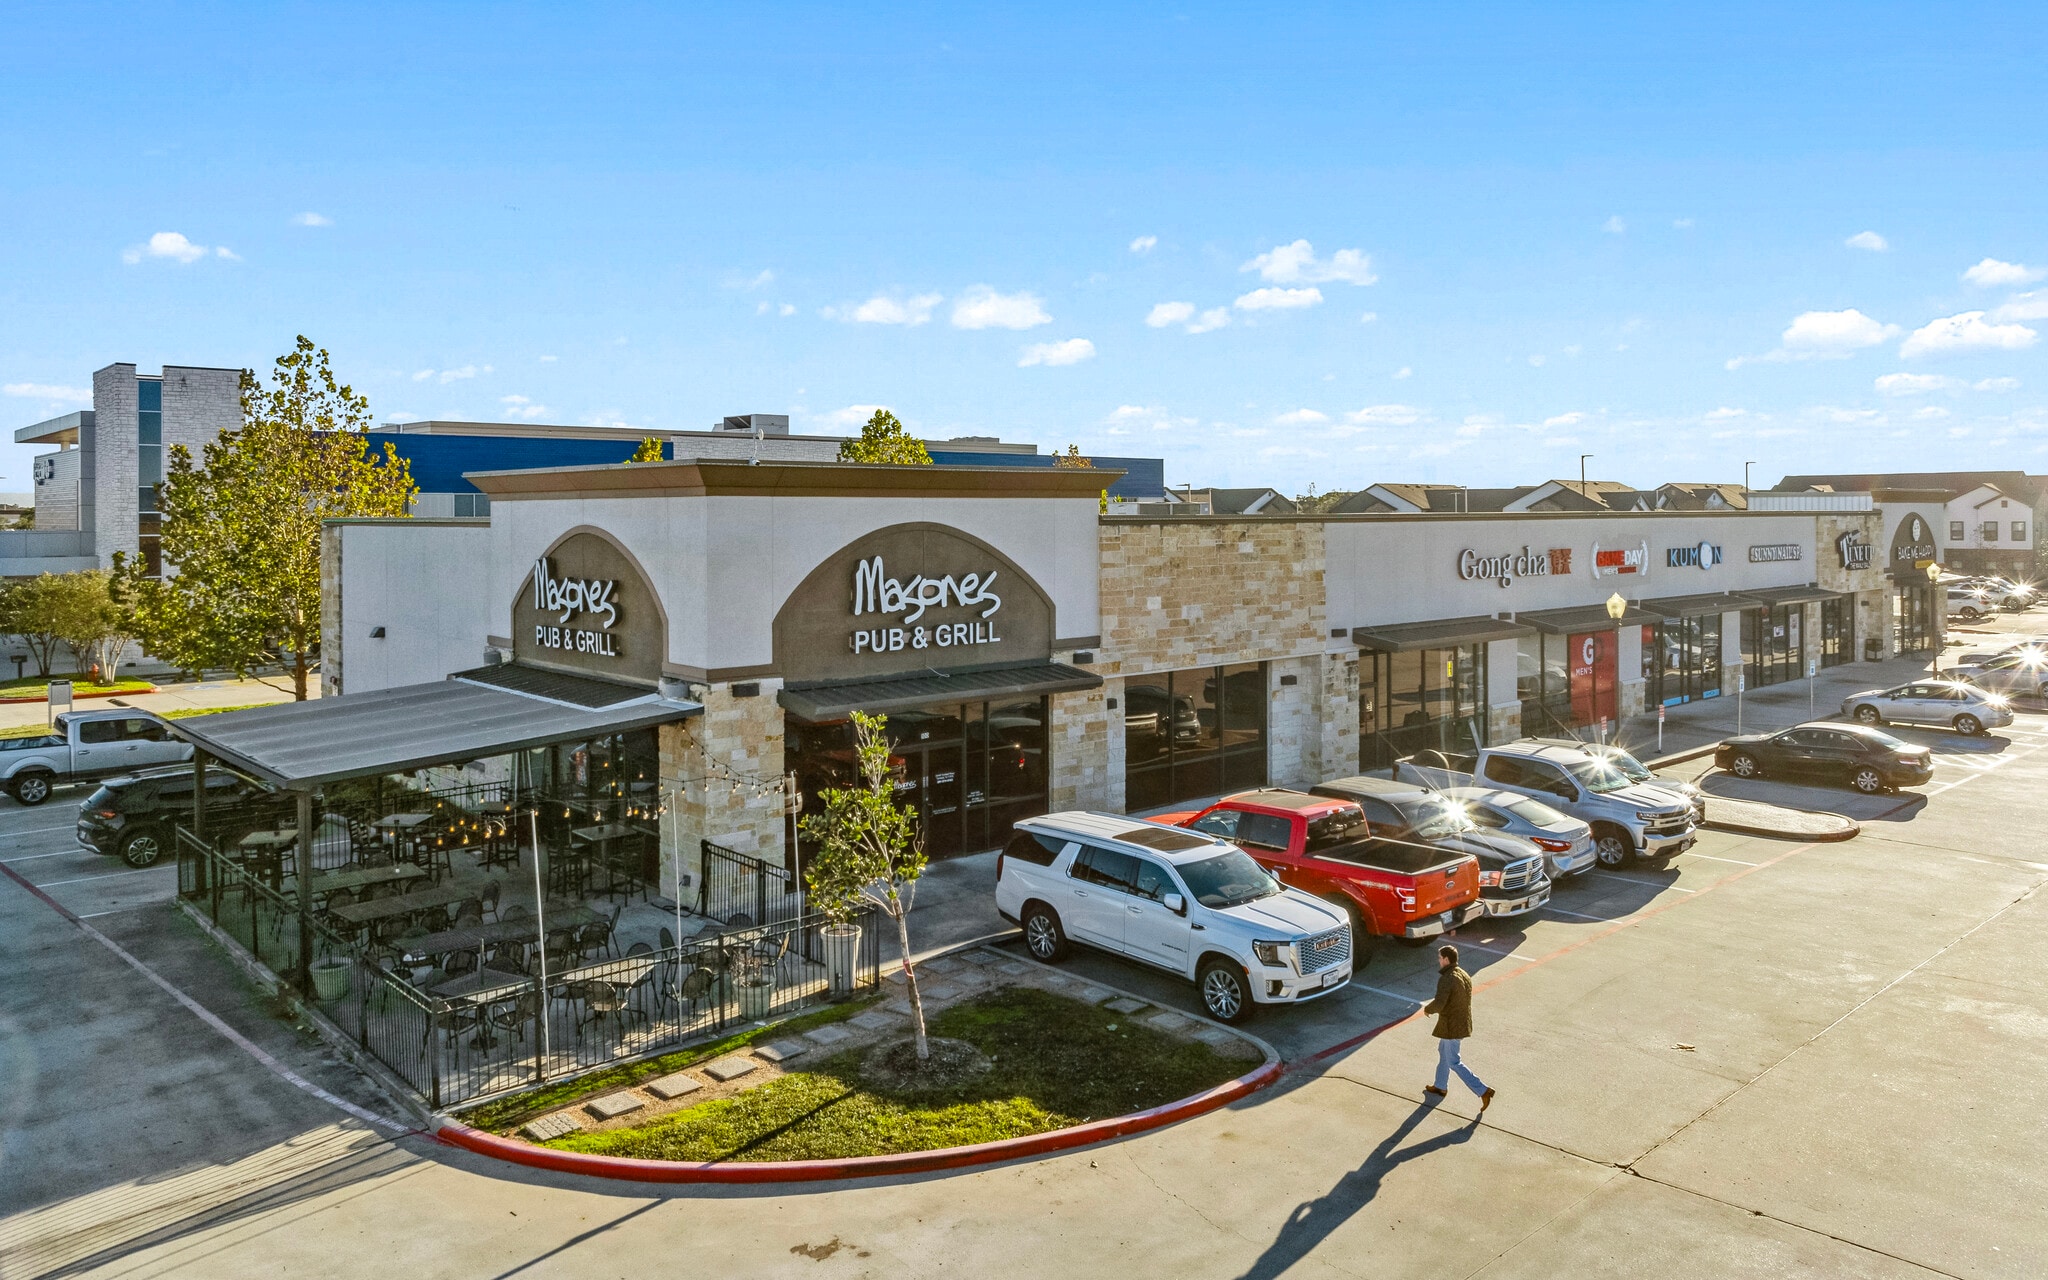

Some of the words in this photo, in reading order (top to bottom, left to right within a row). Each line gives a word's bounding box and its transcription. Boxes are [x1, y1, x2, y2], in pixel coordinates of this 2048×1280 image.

[1460, 548, 1512, 588] Gong
[1517, 546, 1548, 576] cha
[1670, 542, 1722, 569] KUMON
[536, 625, 561, 648] PUB
[564, 628, 573, 650] &
[576, 630, 616, 657] GRILL
[855, 628, 904, 654] PUB
[912, 626, 928, 649] &
[935, 621, 1001, 647] GRILL
